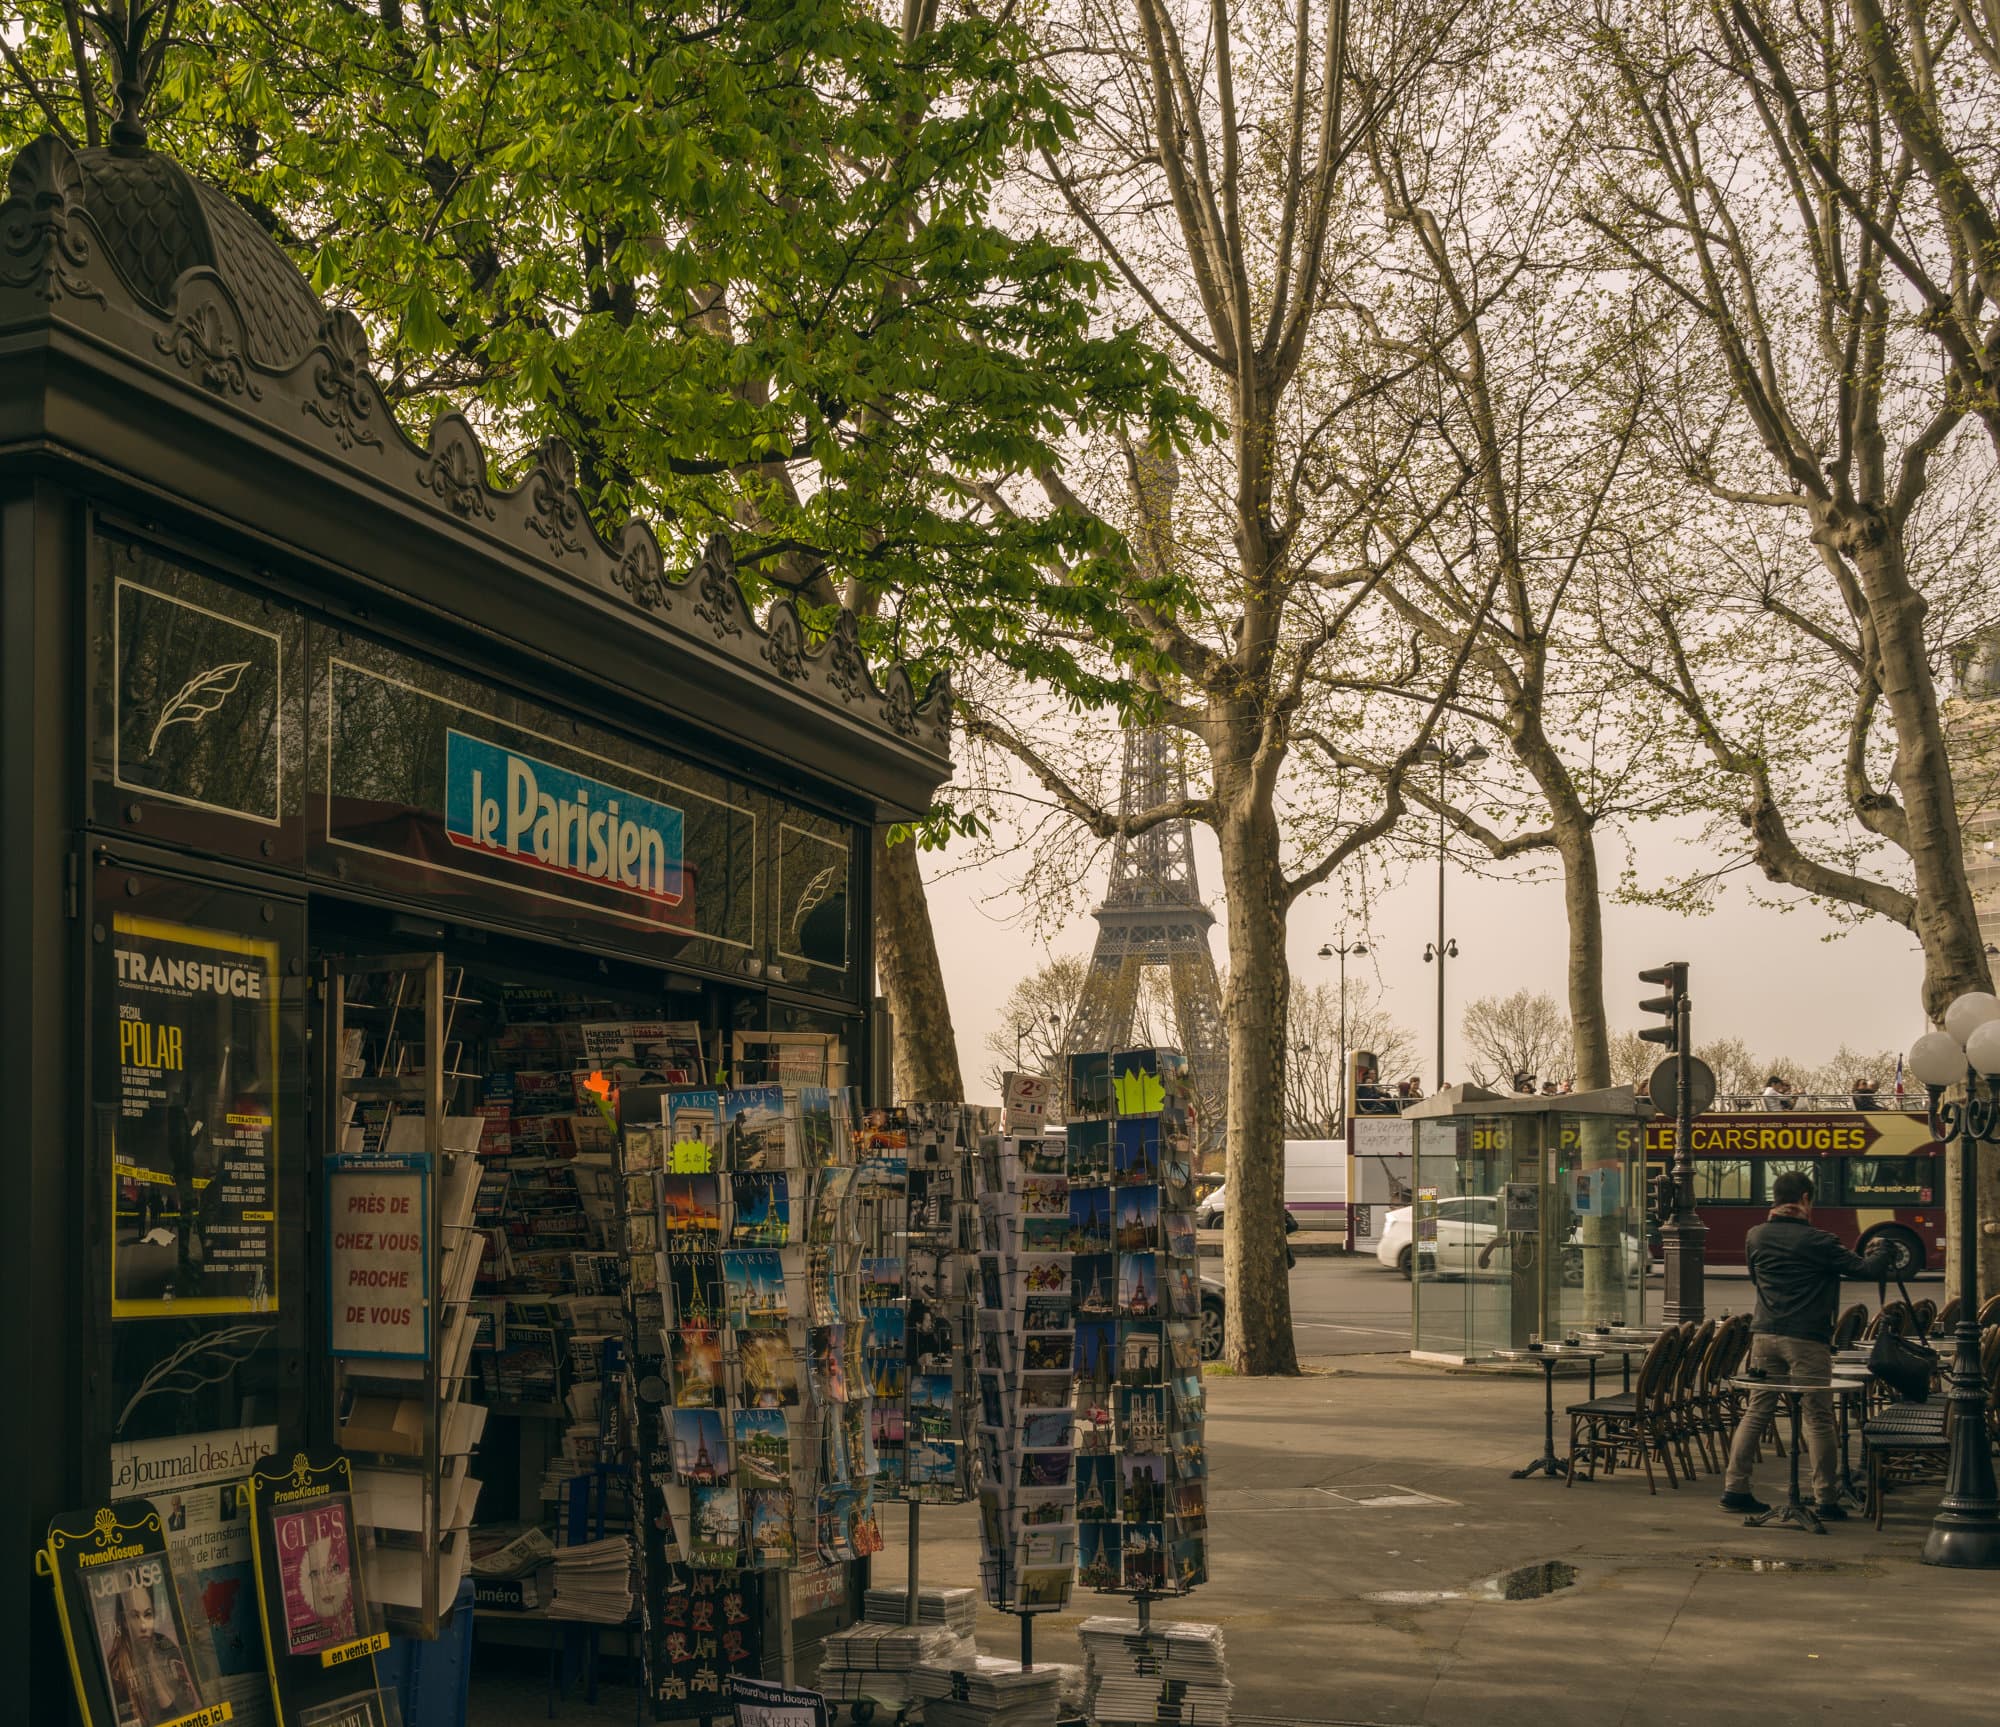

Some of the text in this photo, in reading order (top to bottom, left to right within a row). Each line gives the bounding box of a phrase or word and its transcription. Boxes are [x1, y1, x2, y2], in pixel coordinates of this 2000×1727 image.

[472, 754, 665, 896] le Parisien
[114, 949, 261, 1000] TRANSFUGE
[119, 1019, 183, 1071] POLAR
[671, 1094, 717, 1107] PARIS
[727, 1090, 777, 1105] PARIS
[734, 1175, 786, 1188] PARIS
[1855, 1185, 1921, 1193] HOP-ON HOP-OFF
[348, 1192, 409, 1214] PRÈS DE
[335, 1233, 373, 1250] CHEZ
[673, 1254, 716, 1265] PARIS
[724, 1253, 774, 1265] PARIS
[348, 1270, 409, 1288] PROCHE
[346, 1306, 411, 1325] DE VOUS
[735, 1411, 782, 1422] PARIS
[274, 1484, 330, 1503] PromoKiosque
[744, 1490, 793, 1502] PARIS
[188, 1533, 202, 1548] ont
[78, 1543, 145, 1568] PromoKiosque
[197, 1551, 208, 1563] de
[210, 1546, 229, 1561] l'art
[687, 1551, 734, 1565] PARIS
[474, 1585, 520, 1604] uméro
[332, 1635, 382, 1664] en vente ici
[769, 1693, 781, 1703] en
[210, 1706, 224, 1722] ici
